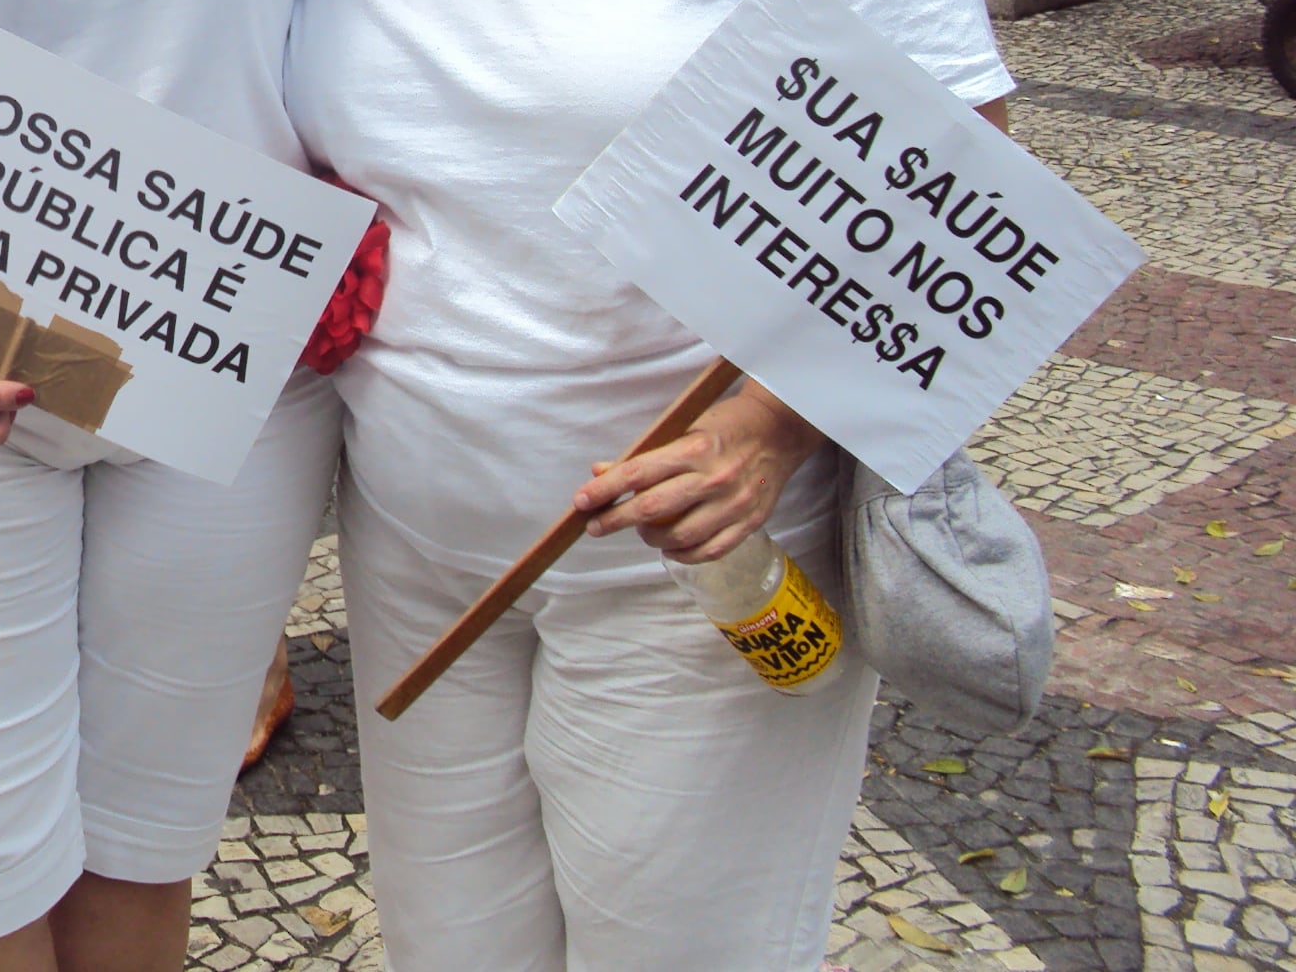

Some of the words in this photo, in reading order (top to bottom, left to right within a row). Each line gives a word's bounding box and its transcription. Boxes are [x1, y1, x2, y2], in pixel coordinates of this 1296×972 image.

[137, 170, 323, 278] SAÚDE
[724, 107, 894, 253] MUITO
[888, 240, 1005, 339] NOS
[776, 57, 884, 161] $UA
[885, 146, 1060, 293] $AÚDE
[25, 250, 250, 384] PRIVADA
[202, 264, 246, 313] É
[679, 163, 946, 391] INTERE$$A
